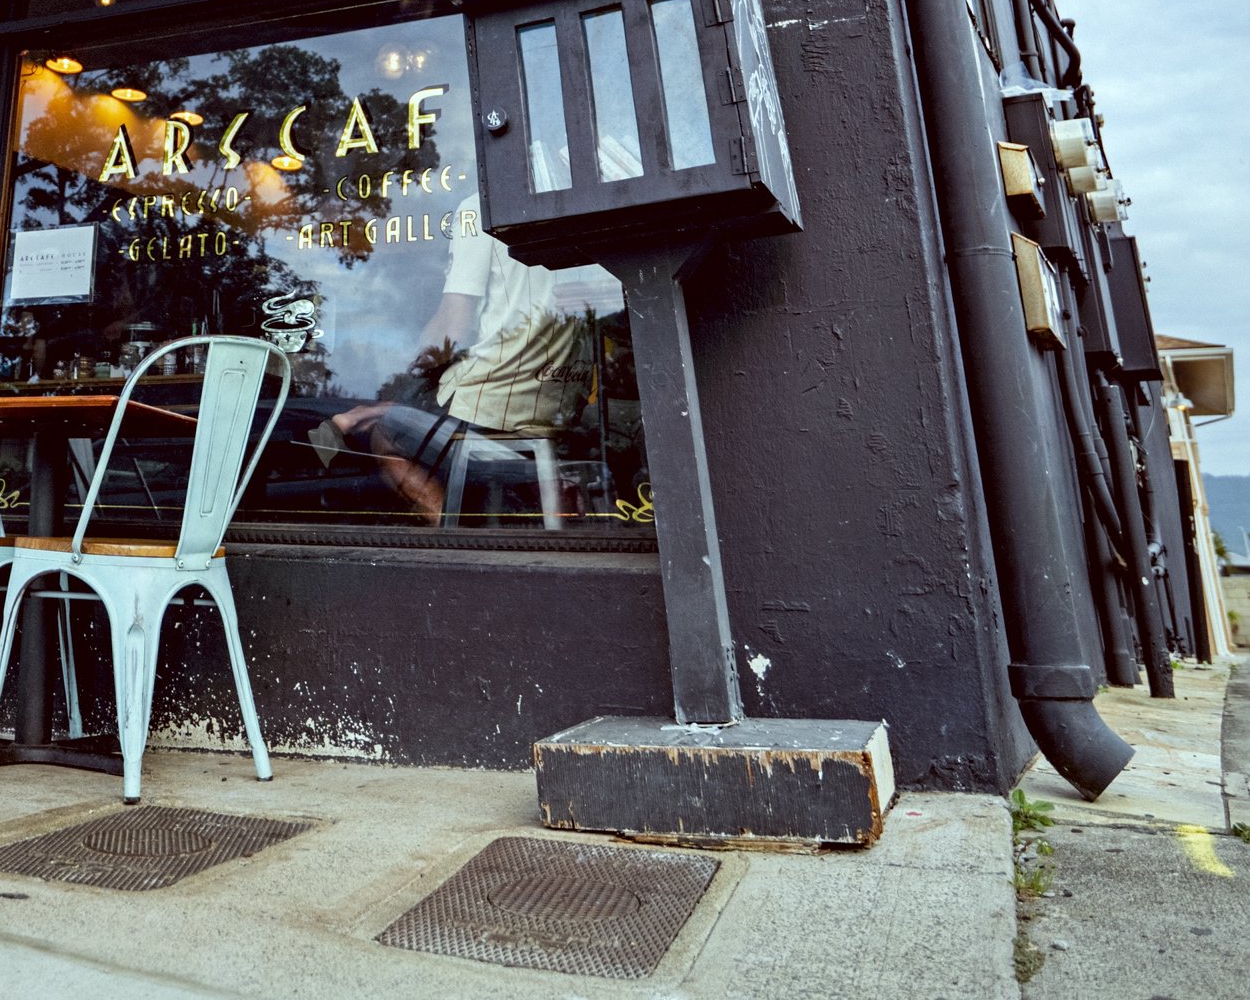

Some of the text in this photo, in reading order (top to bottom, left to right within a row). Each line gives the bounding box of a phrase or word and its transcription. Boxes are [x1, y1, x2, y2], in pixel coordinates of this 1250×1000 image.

[99, 85, 448, 182] ARS CAF
[364, 209, 478, 245] GALLER
